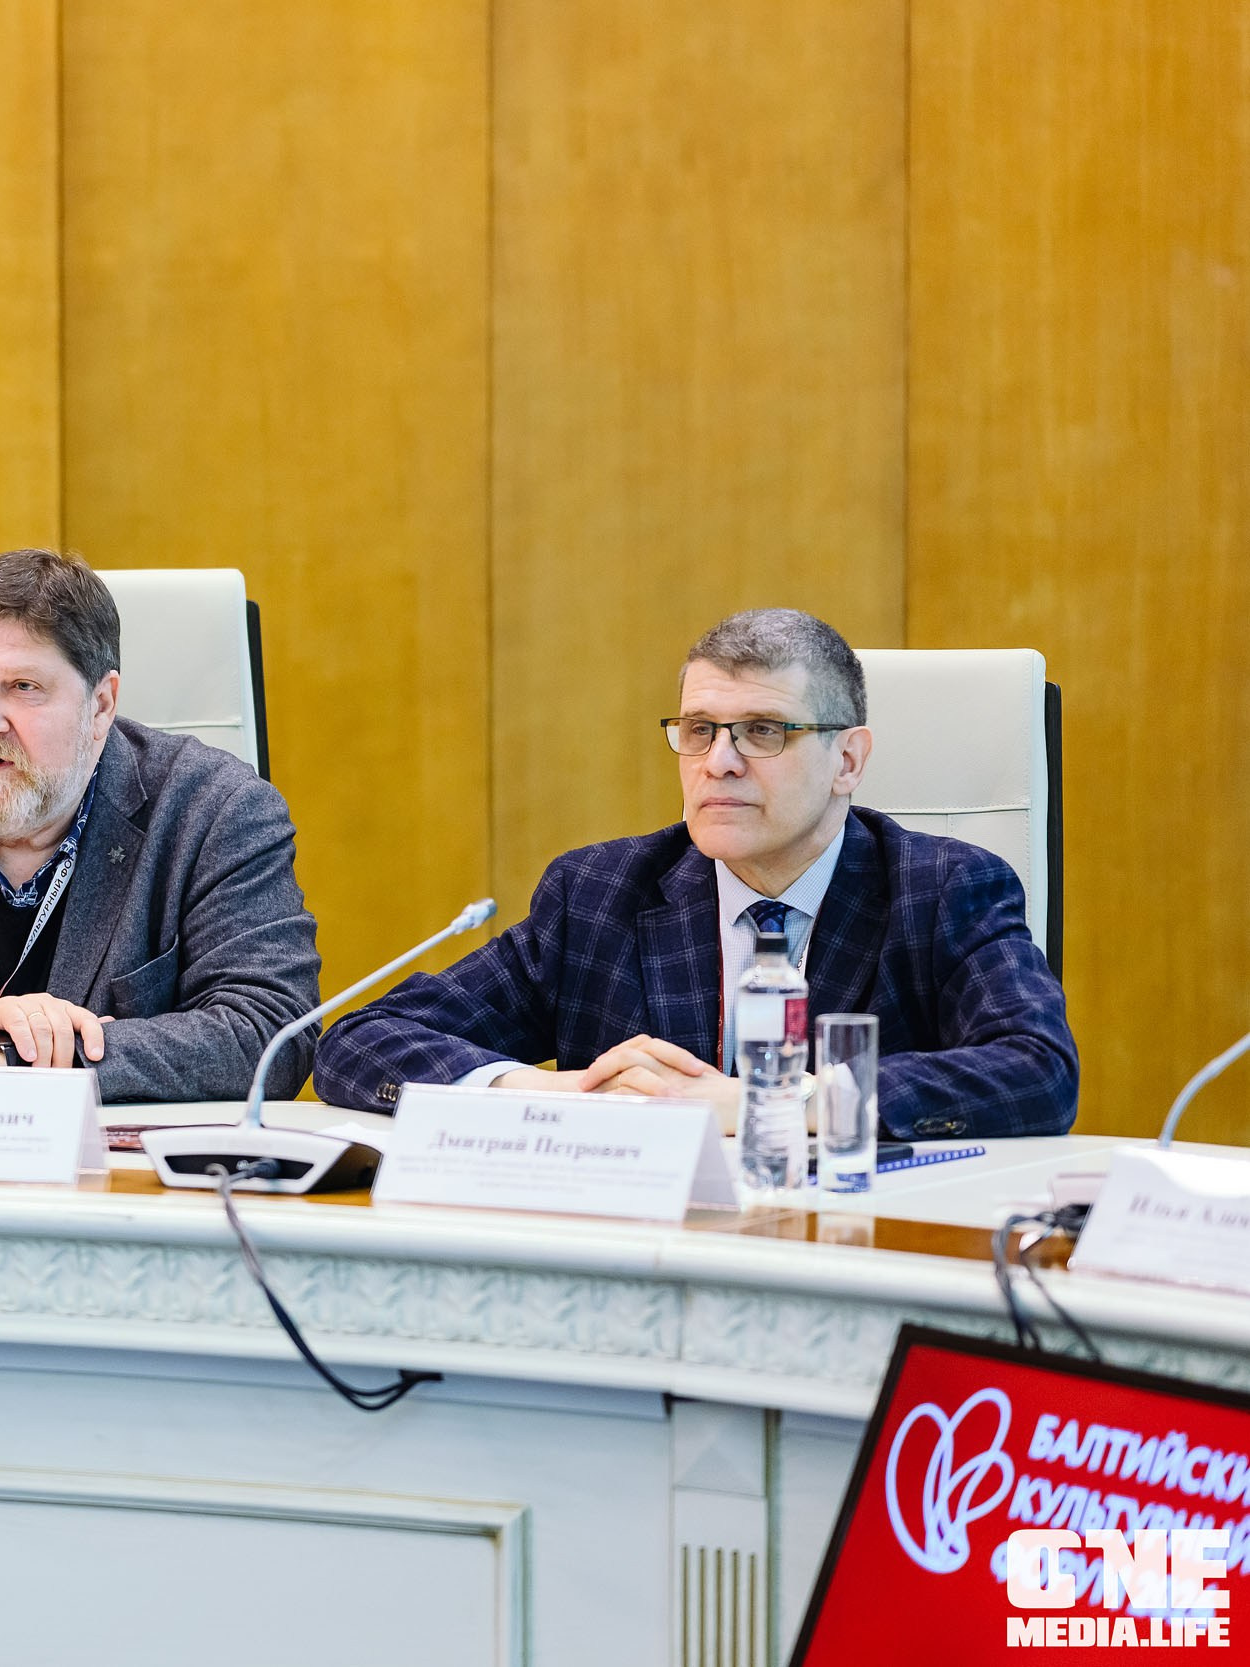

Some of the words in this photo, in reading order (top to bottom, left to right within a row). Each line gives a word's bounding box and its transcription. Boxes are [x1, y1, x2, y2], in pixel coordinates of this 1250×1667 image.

[26, 879, 63, 949] КУЛЬТУРНЫЙ
[522, 1104, 562, 1123] Бак
[427, 1129, 529, 1155] Дмитрий
[534, 1135, 642, 1160] Петрович
